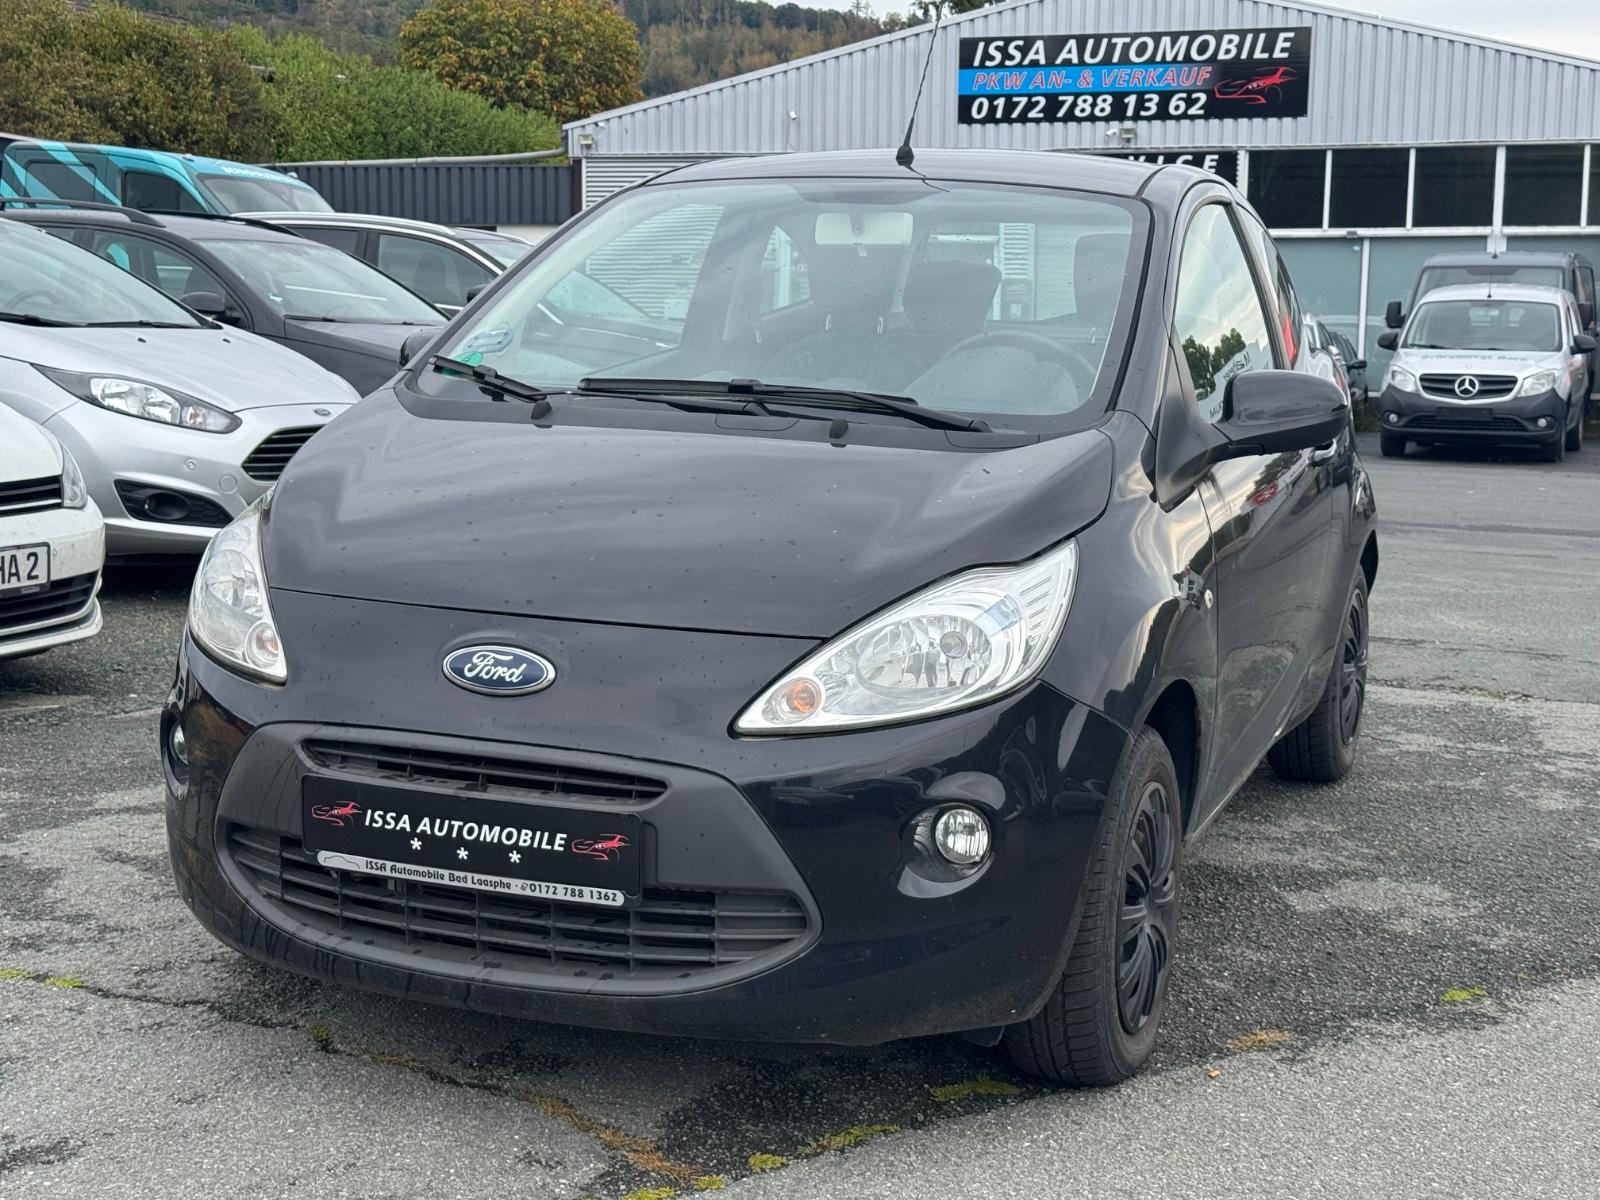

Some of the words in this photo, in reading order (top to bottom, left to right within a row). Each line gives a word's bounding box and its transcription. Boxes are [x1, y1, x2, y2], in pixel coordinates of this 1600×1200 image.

[973, 39, 1046, 67] ISSA
[1055, 31, 1295, 65] AUTOMOBILE
[972, 71, 1028, 91] PKW
[1029, 70, 1073, 90] AN-
[1077, 69, 1095, 89] &
[1102, 66, 1212, 88] VERKAUF
[970, 96, 1047, 120] 0172
[1056, 94, 1114, 119] 788
[1123, 93, 1160, 117] 13
[1168, 92, 1208, 116] 62
[27, 551, 39, 581] 2
[464, 651, 527, 683] Ford
[365, 809, 411, 833] ISSA
[416, 816, 567, 851] AUTOMOBILE
[365, 860, 387, 872] ISSA
[390, 864, 445, 880] Automobile
[448, 872, 468, 884] Bad
[471, 875, 512, 890] Laasphe
[529, 883, 558, 895] 0172
[563, 887, 584, 899] 788
[589, 890, 618, 902] 1362
